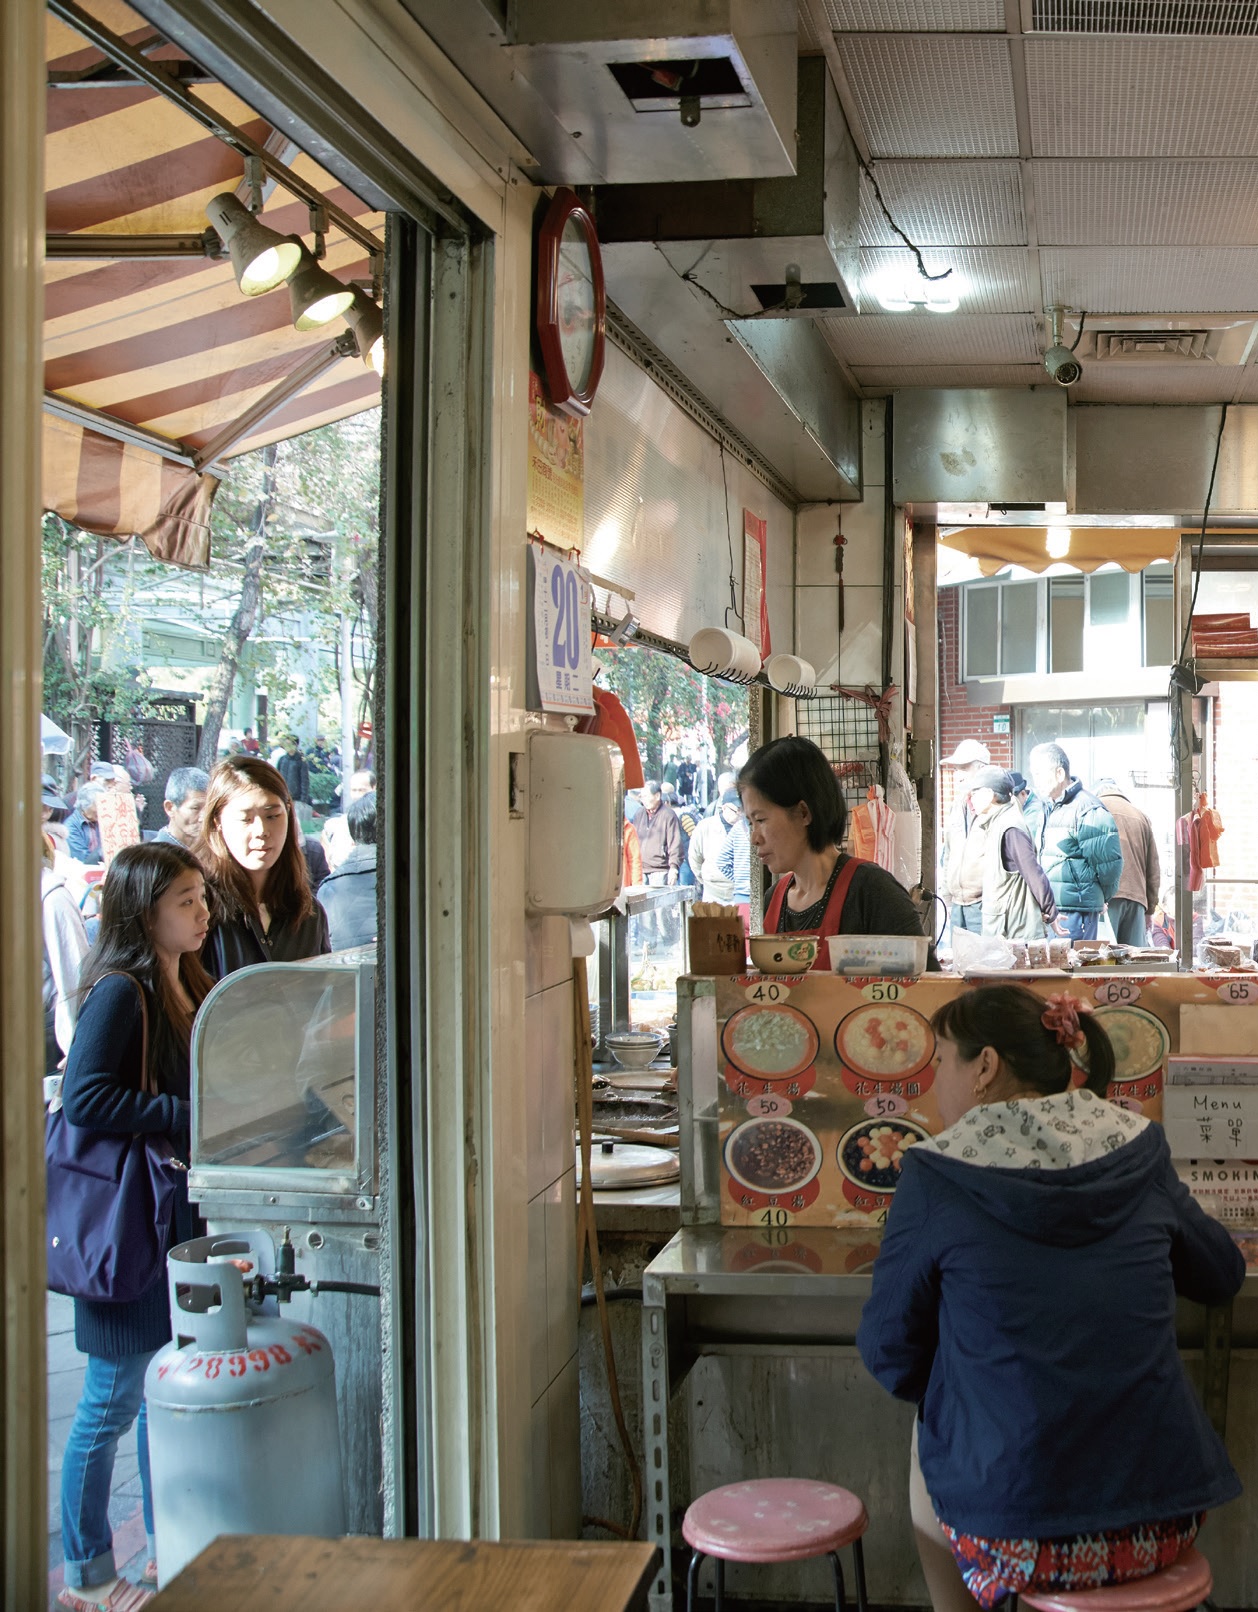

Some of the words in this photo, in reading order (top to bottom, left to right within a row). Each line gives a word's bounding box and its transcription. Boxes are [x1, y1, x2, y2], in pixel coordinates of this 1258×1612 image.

[551, 564, 579, 671] 20
[753, 984, 780, 1001] 40
[871, 983, 899, 1001] 50
[1107, 984, 1131, 1004] 60
[1229, 983, 1249, 999] 65
[737, 1081, 800, 1097] 花生湯
[855, 1081, 921, 1097] 花生湯圓
[760, 1099, 779, 1115] 50
[876, 1098, 896, 1116] 50
[1193, 1095, 1242, 1111] Menu
[1196, 1115, 1244, 1148] 菜單
[741, 1195, 806, 1208] 紅豆湯
[760, 1209, 788, 1226] 40
